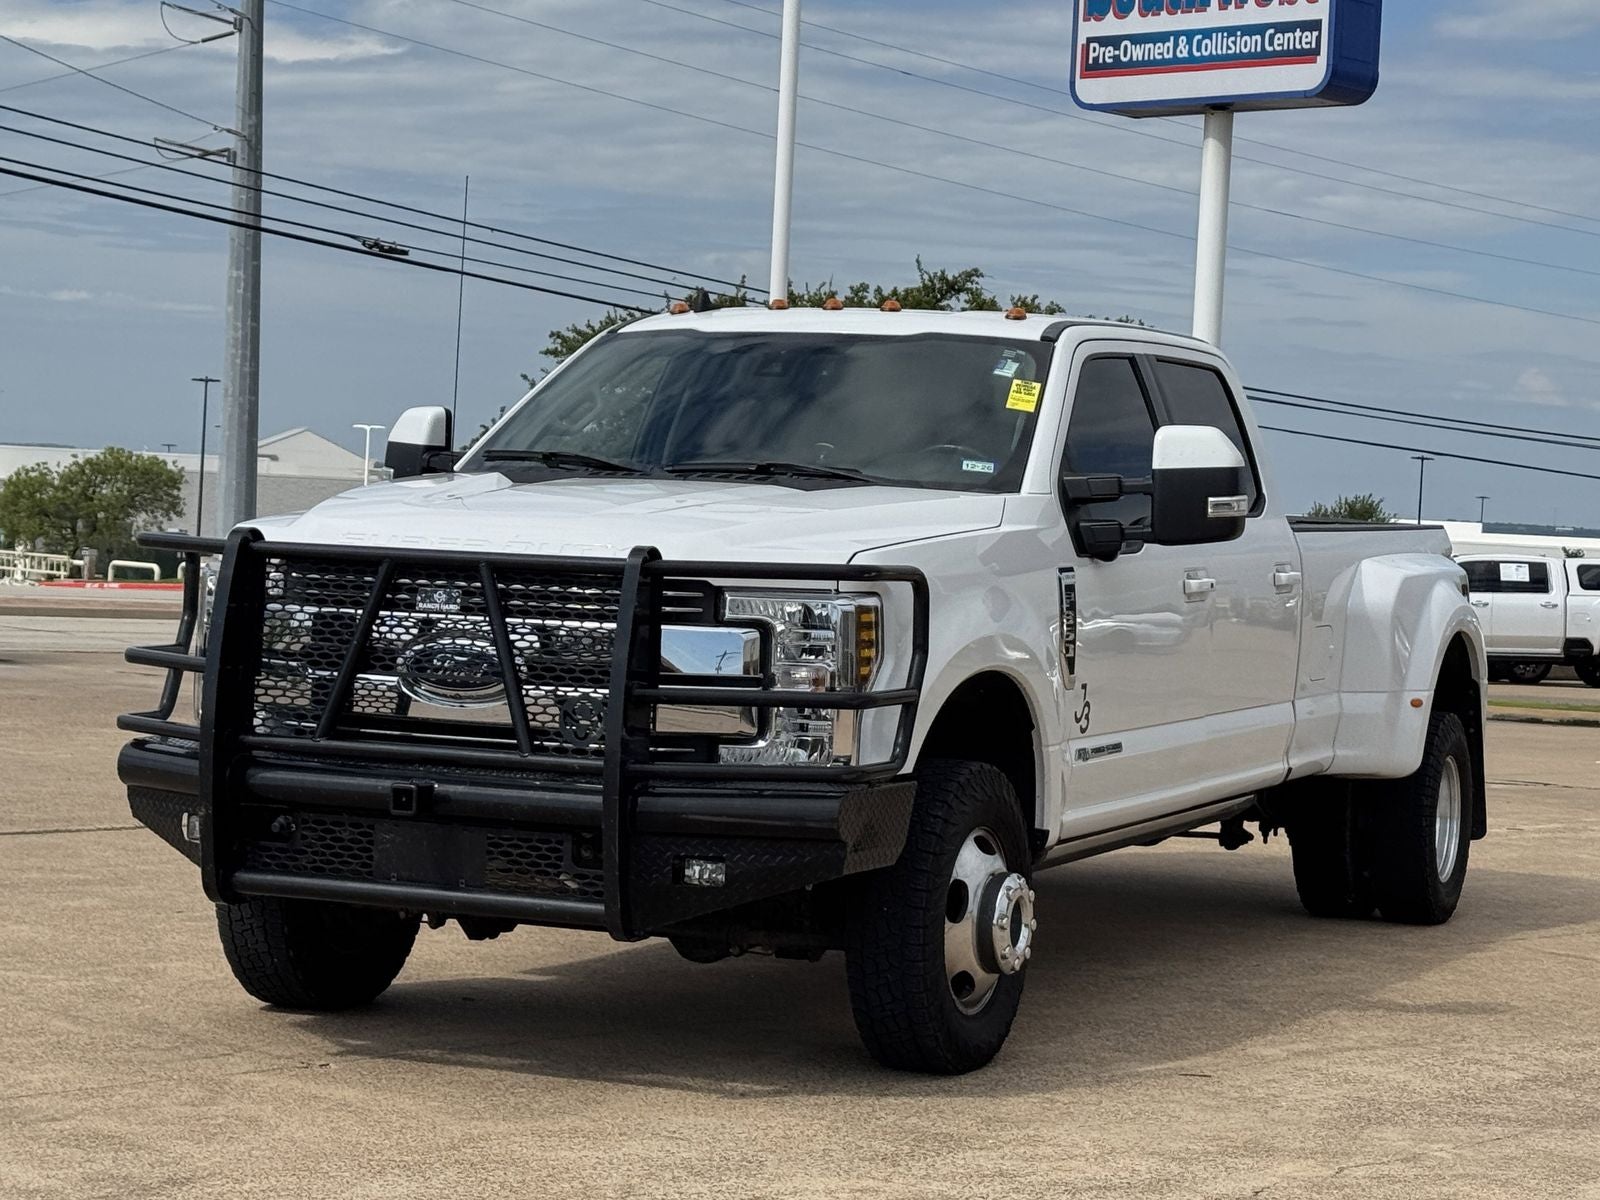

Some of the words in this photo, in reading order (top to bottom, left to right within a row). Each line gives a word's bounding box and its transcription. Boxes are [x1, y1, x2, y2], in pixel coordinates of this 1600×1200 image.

[1088, 35, 1174, 65] Pre-Owned
[1176, 35, 1189, 58] &
[1192, 30, 1262, 57] Collision
[1264, 28, 1319, 52] Center
